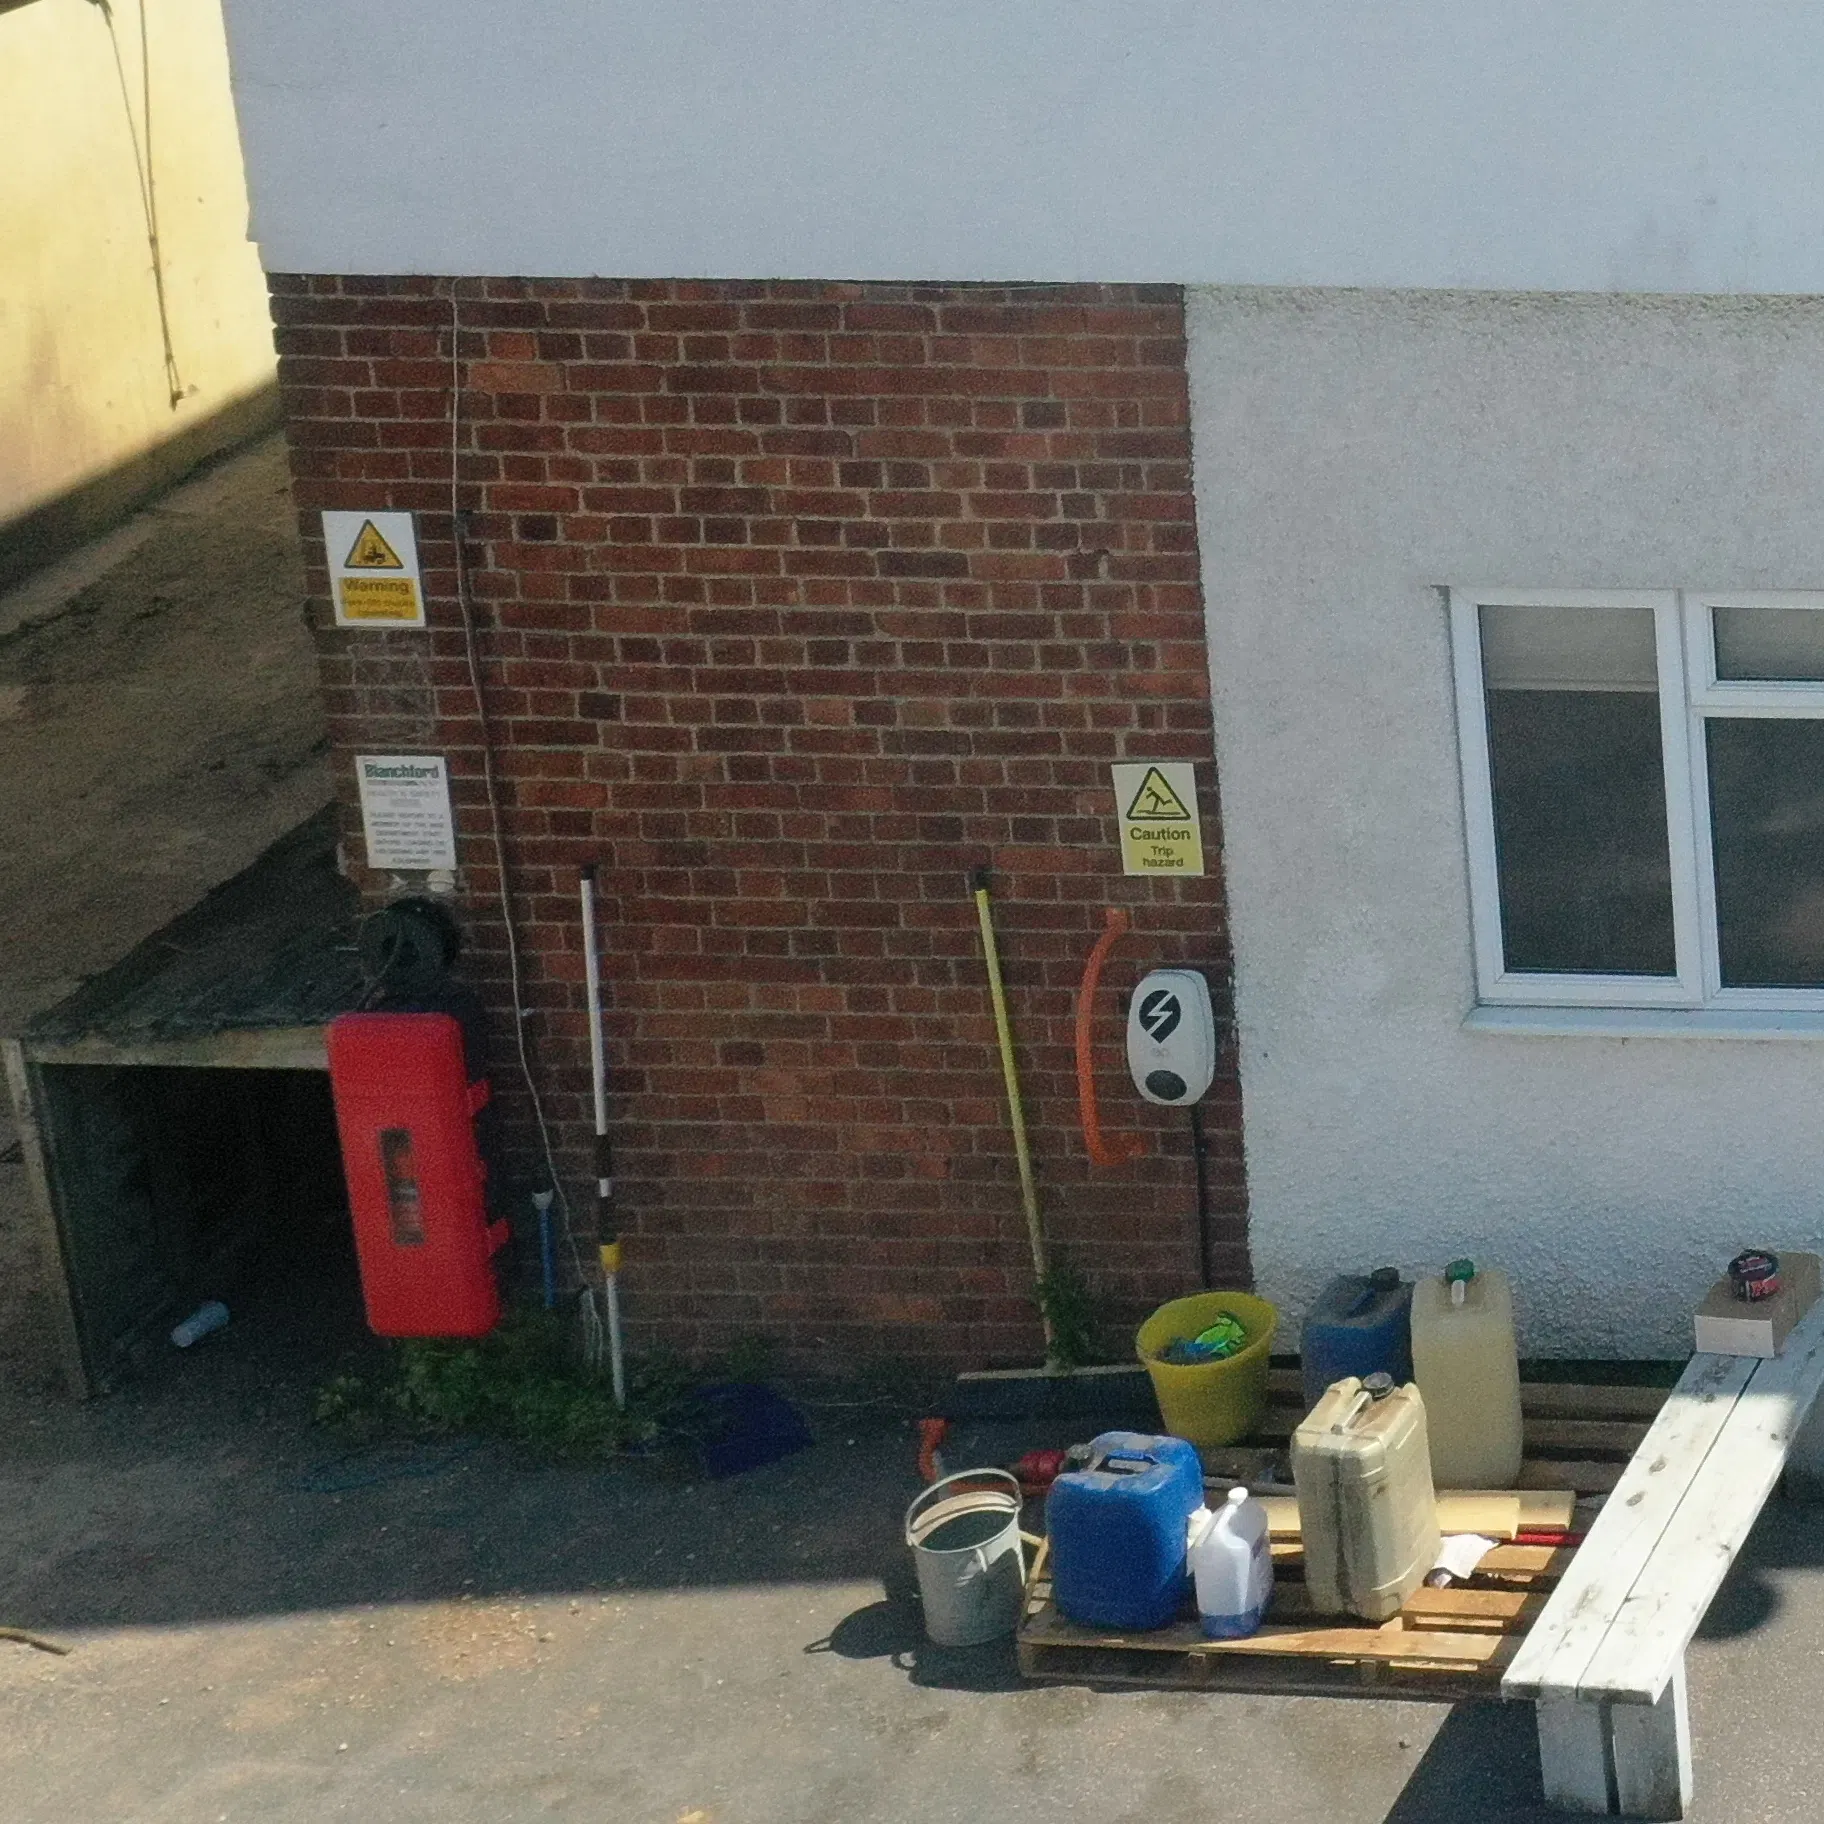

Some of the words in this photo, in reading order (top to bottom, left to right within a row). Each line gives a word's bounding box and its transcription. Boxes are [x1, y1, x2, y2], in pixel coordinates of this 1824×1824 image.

[1130, 827, 1191, 840] Caution
[1150, 845, 1174, 858] Trip
[1142, 858, 1184, 867] hazard
